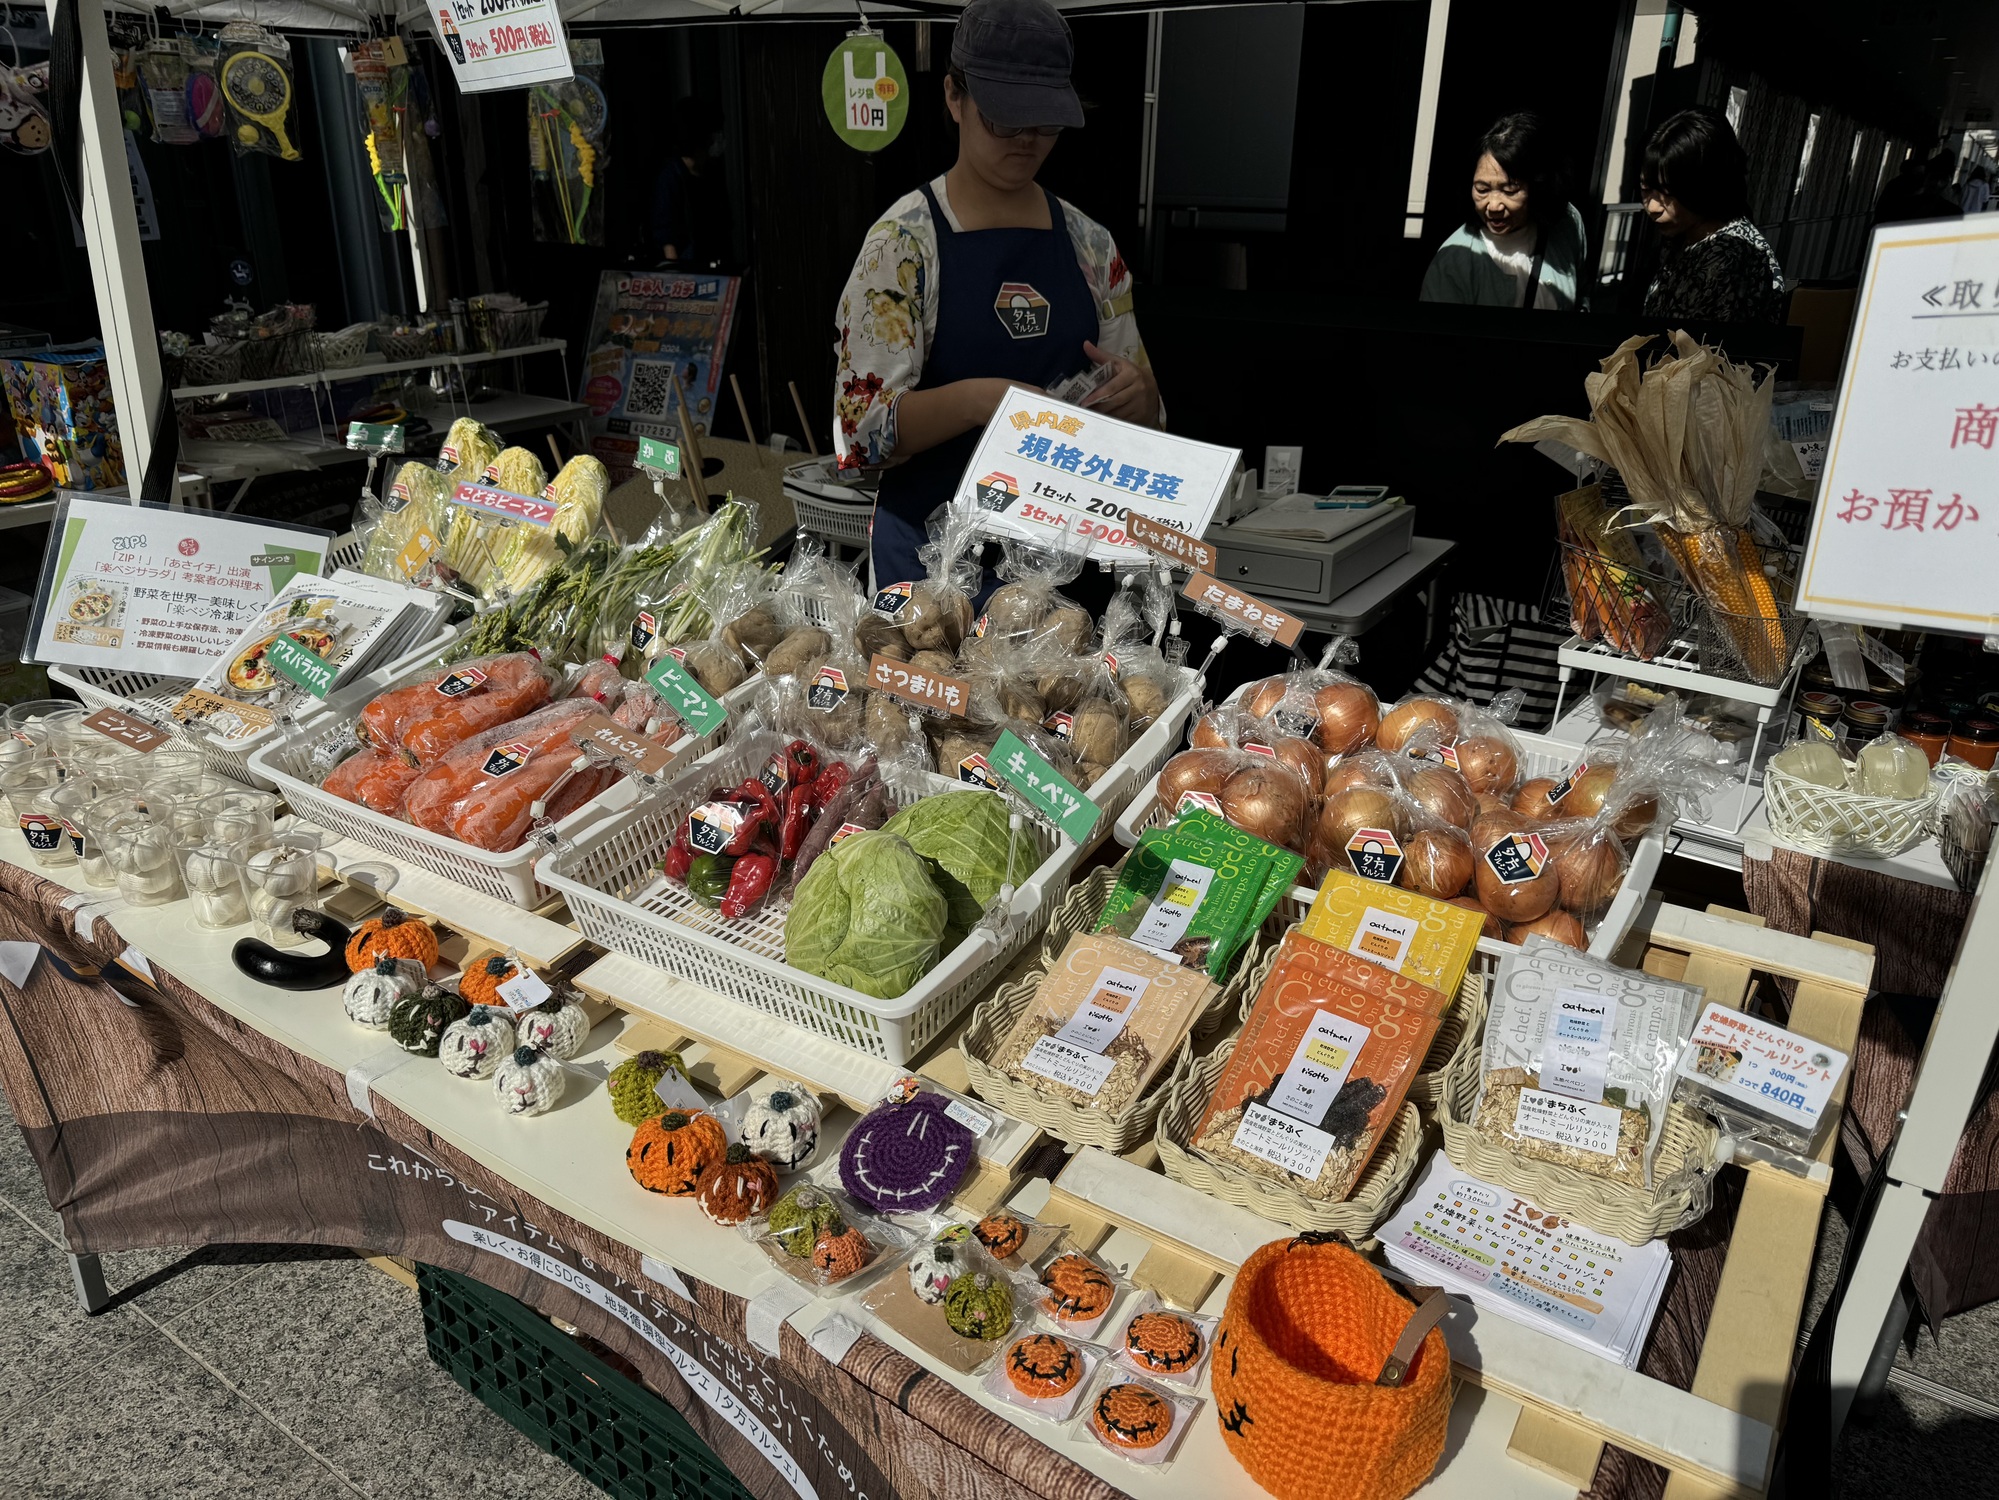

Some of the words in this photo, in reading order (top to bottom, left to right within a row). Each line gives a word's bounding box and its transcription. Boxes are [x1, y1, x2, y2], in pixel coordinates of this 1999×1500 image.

[465, 37, 489, 59] 3セット
[489, 20, 556, 56] 500円(税込)
[849, 87, 874, 99] レジ袋
[878, 83, 895, 95] 有料
[851, 102, 884, 127] 10円
[1012, 308, 1037, 326] 夕方
[1012, 322, 1041, 333] マルシェ
[633, 423, 673, 438] 437252
[1008, 410, 1085, 437] 県内産
[642, 442, 676, 466] かぶ
[1016, 432, 1185, 501] 規格外野菜
[460, 486, 548, 520] こどもピーマン
[1031, 481, 1078, 504] 1セット
[1020, 503, 1068, 527] 3セット
[112, 534, 148, 551] ZIP!
[251, 554, 291, 564] サインつき
[1202, 584, 1285, 631] たまねぎ
[138, 629, 237, 647] 冷凍野菜のおいしいレシ
[272, 639, 332, 690] アスパラガス
[658, 667, 709, 717] ピーマン
[814, 685, 833, 703] 夕方
[874, 663, 961, 707] さつまいも
[97, 715, 156, 744] ニンニク
[594, 727, 648, 759] れんこん
[1007, 749, 1081, 819] キャベツ
[29, 830, 50, 843] 夕方
[699, 823, 719, 843] 夕方
[1362, 853, 1386, 871] 夕方
[1501, 846, 1520, 871] 夕方
[1174, 873, 1202, 885] oatmeal
[1360, 865, 1387, 879] マルシェ
[1369, 921, 1406, 936] oatmeal
[1106, 979, 1137, 992] oatmeal
[1088, 1010, 1113, 1023] risotto
[1561, 1002, 1606, 1016] oatmeal
[1317, 1026, 1353, 1044] oatmeal
[1515, 1006, 1533, 1043] chef.
[1708, 1011, 1805, 1055] 乾燥野菜とどんぐりの
[1057, 1046, 1089, 1063] まちふく
[1701, 1023, 1831, 1082] オートミールリゾット
[1033, 1053, 1098, 1082] オートミールリゾット
[1301, 1067, 1330, 1083] risotto
[1769, 1067, 1796, 1085] 300円
[1738, 1077, 1759, 1090] 3つで
[1760, 1081, 1806, 1111] 840円
[1546, 1099, 1587, 1117] まちふく
[1268, 1117, 1304, 1138] まちふく
[1523, 1112, 1609, 1139] オートミールリゾット
[1243, 1126, 1316, 1164] オートミールリゾット
[1502, 1213, 1552, 1238] machifuku
